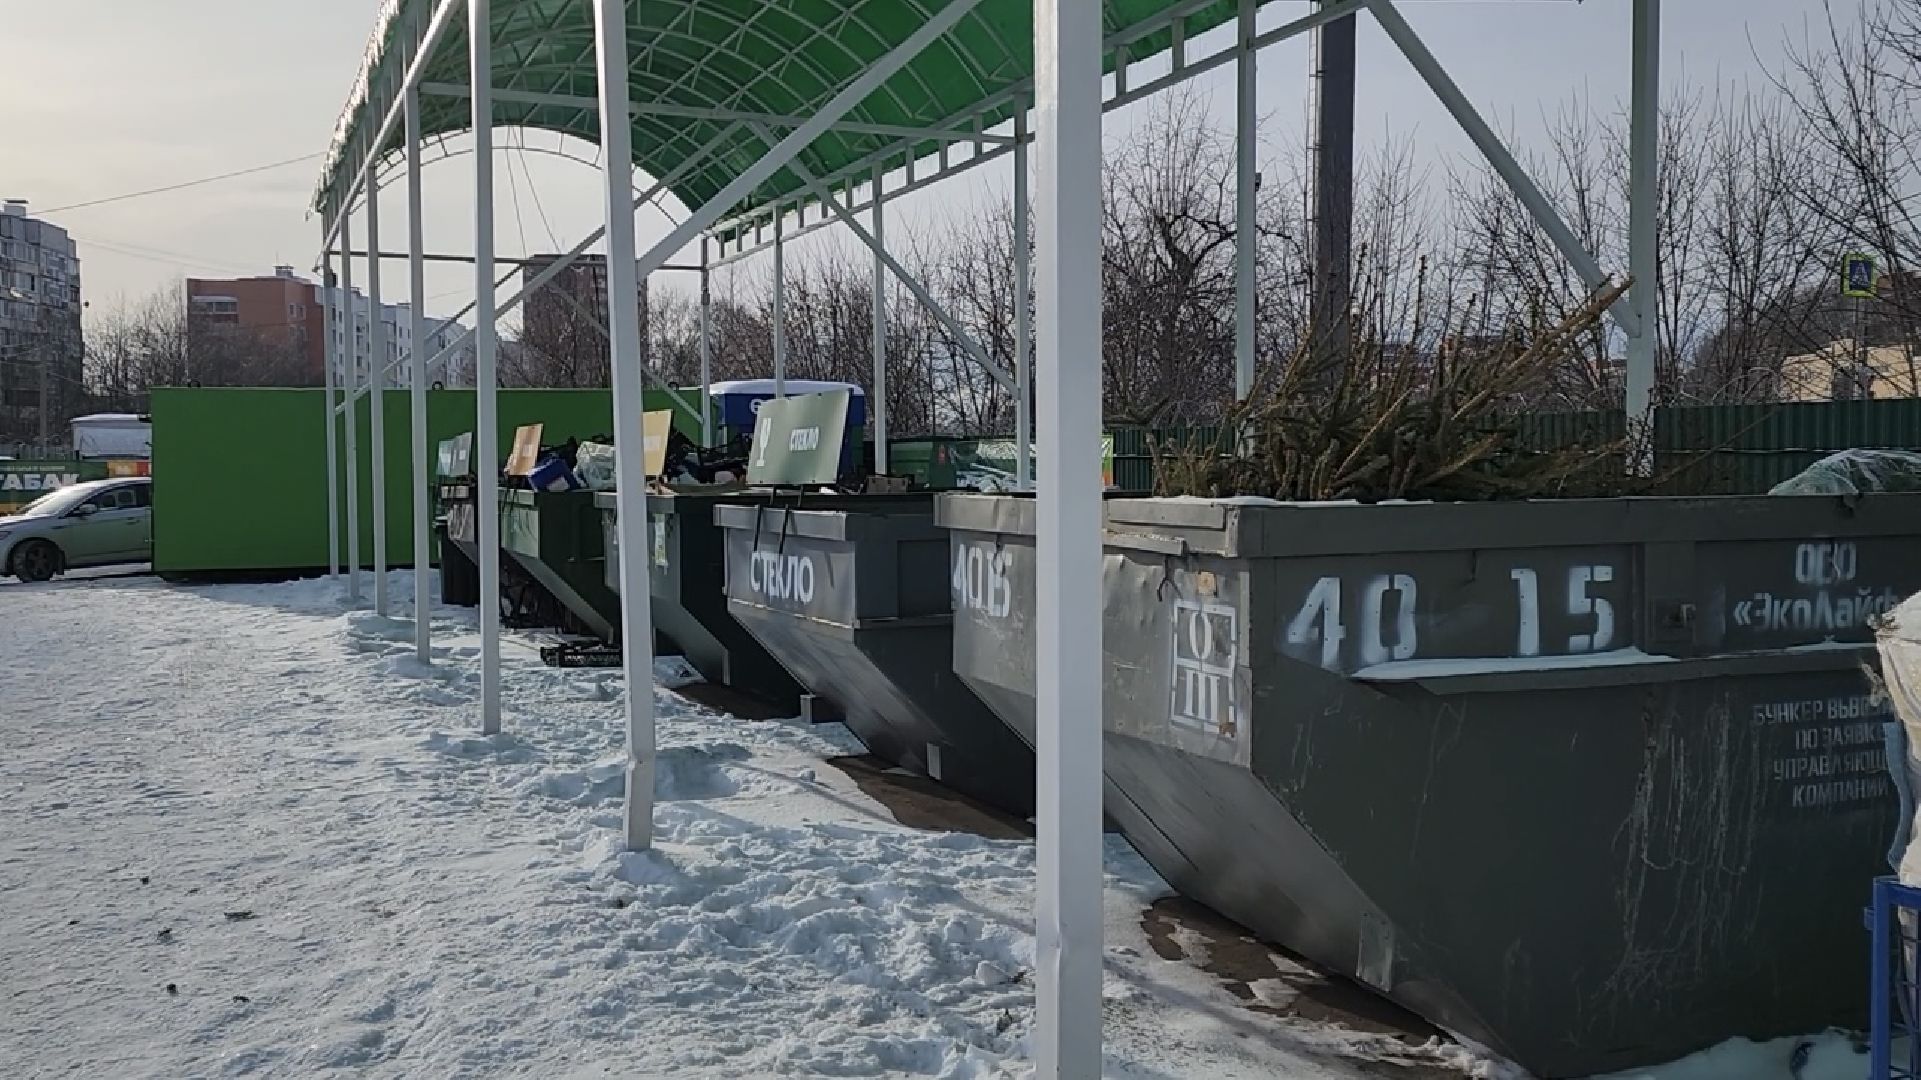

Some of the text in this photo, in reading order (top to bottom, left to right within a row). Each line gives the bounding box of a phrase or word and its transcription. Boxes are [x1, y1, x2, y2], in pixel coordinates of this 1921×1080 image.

[0, 473, 80, 490] АБАК
[750, 550, 814, 604] СТЕКЛО
[1287, 565, 1614, 669] 40 15
[1752, 700, 1823, 725] БУНКЕР
[1795, 728, 1818, 750] ПО
[1773, 750, 1889, 780] УПРАВЛЯЮЩ
[1792, 777, 1889, 808] КОМПАНИИ
